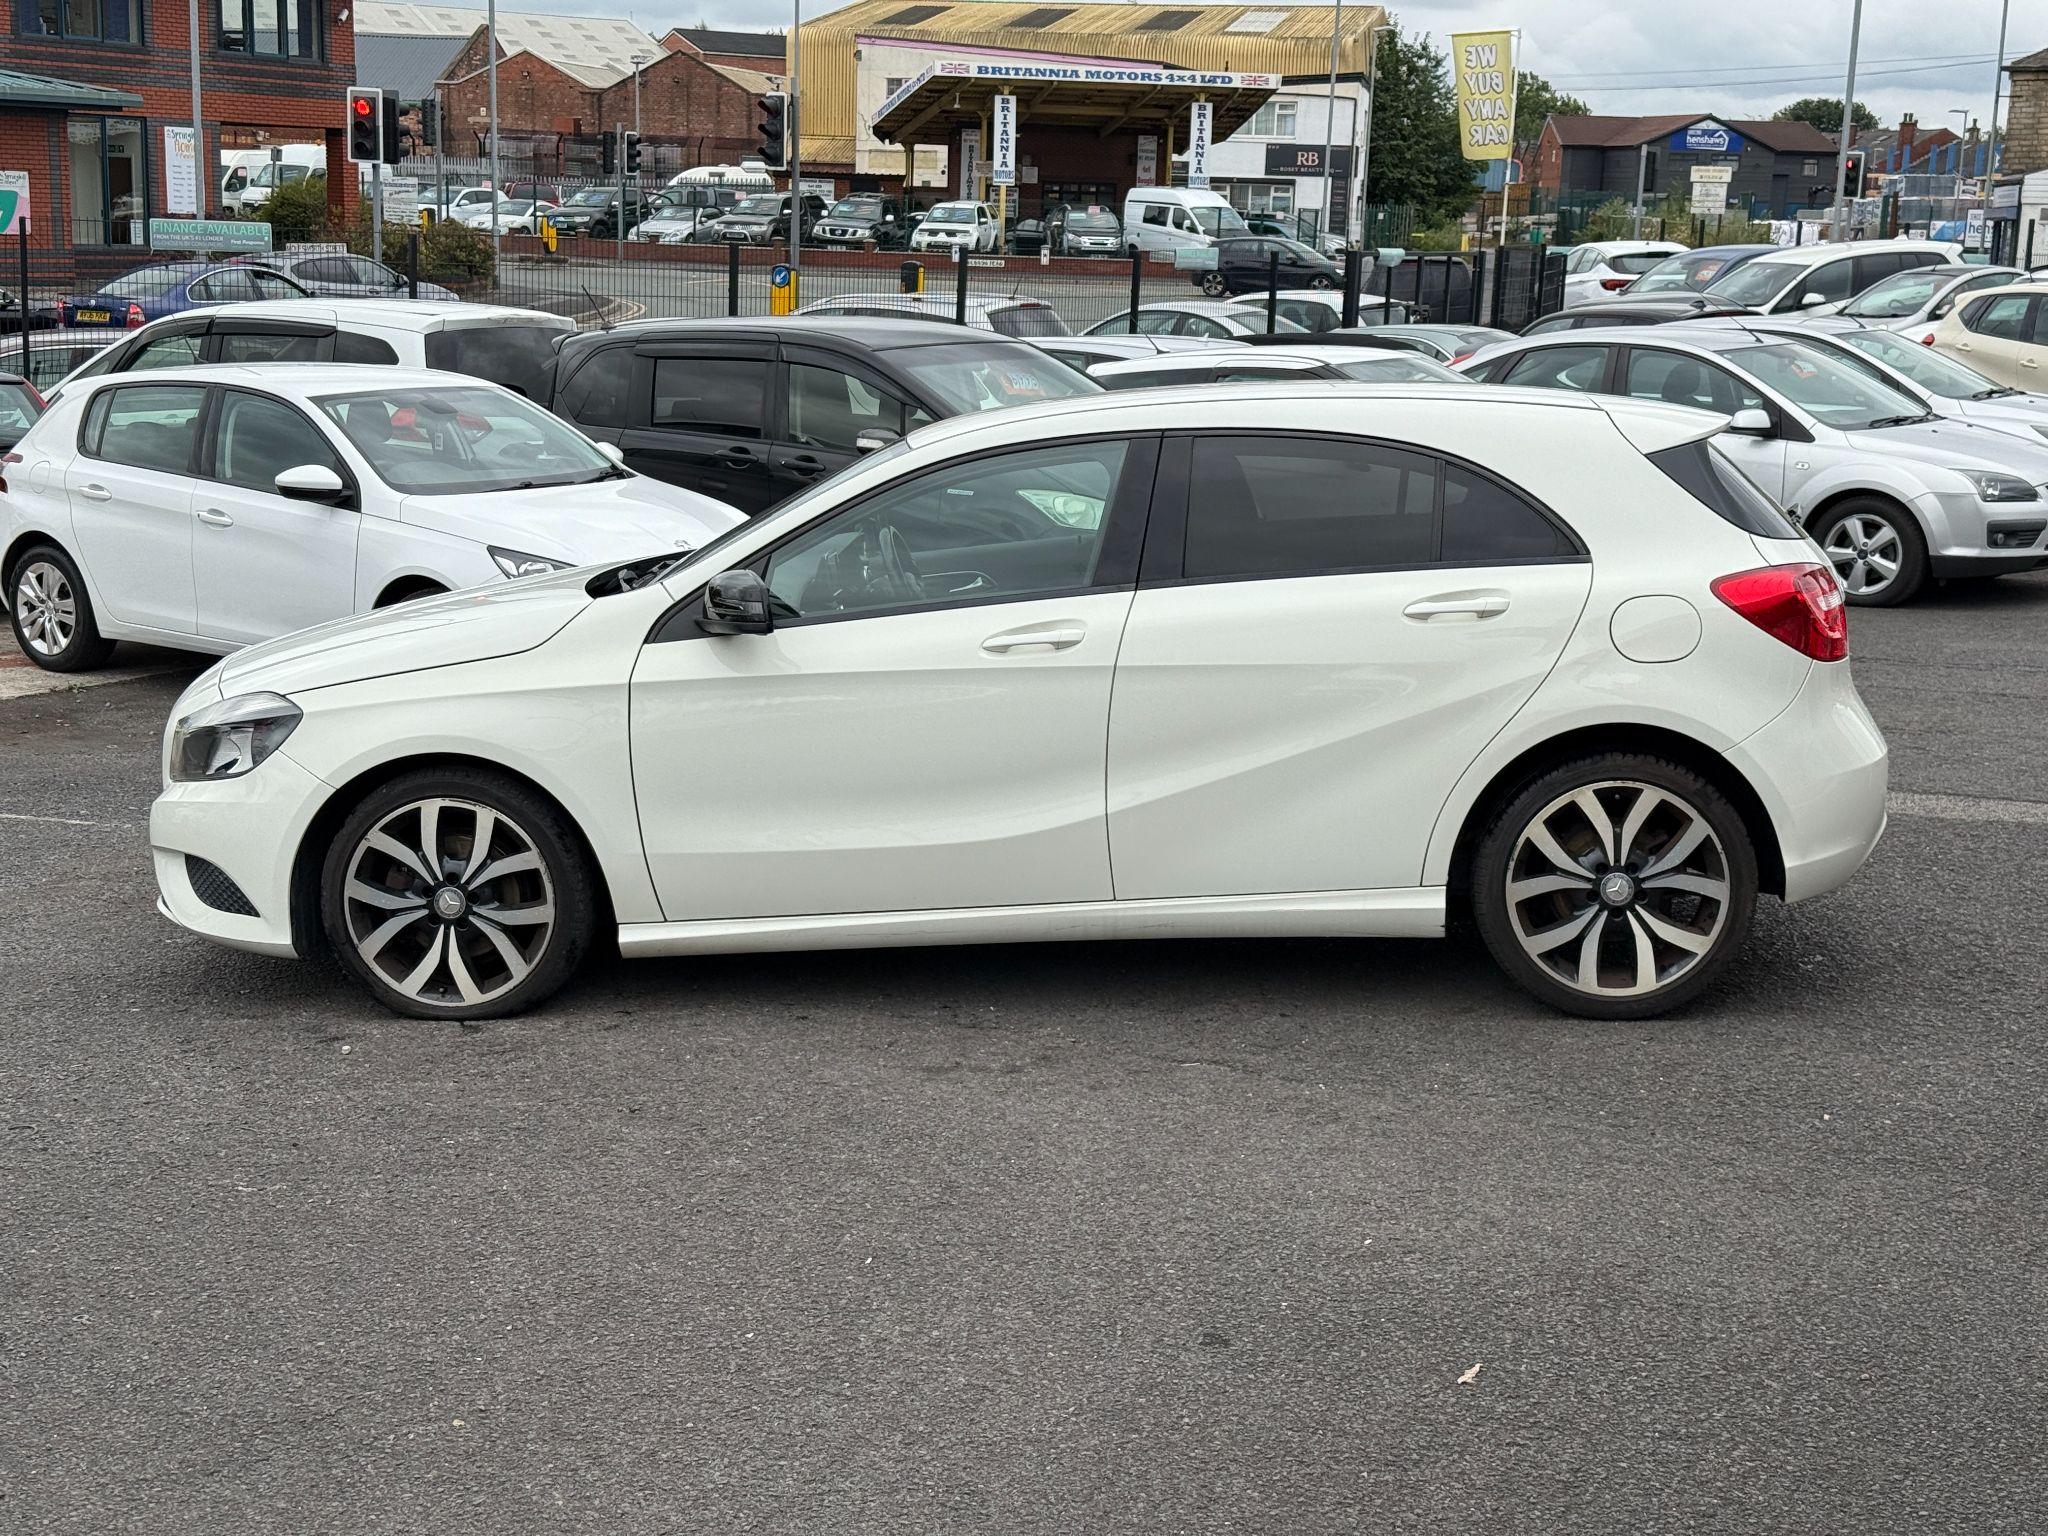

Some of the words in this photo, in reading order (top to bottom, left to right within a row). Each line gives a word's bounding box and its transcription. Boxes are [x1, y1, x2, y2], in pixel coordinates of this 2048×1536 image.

[977, 65, 1080, 78] BRITANNIA
[1085, 70, 1162, 82] MOTORS
[1165, 74, 1197, 83] 4x4
[1199, 75, 1233, 85] LTD
[171, 129, 195, 143] Spring
[1000, 97, 1011, 169] BRITANNIA
[1194, 104, 1207, 174] BRITANNIA
[1686, 135, 1724, 144] henshaws
[1296, 151, 1319, 166] RB
[994, 169, 1015, 180] MOTORS
[153, 221, 204, 234] FINANCE
[207, 224, 269, 236] AVAILABLE
